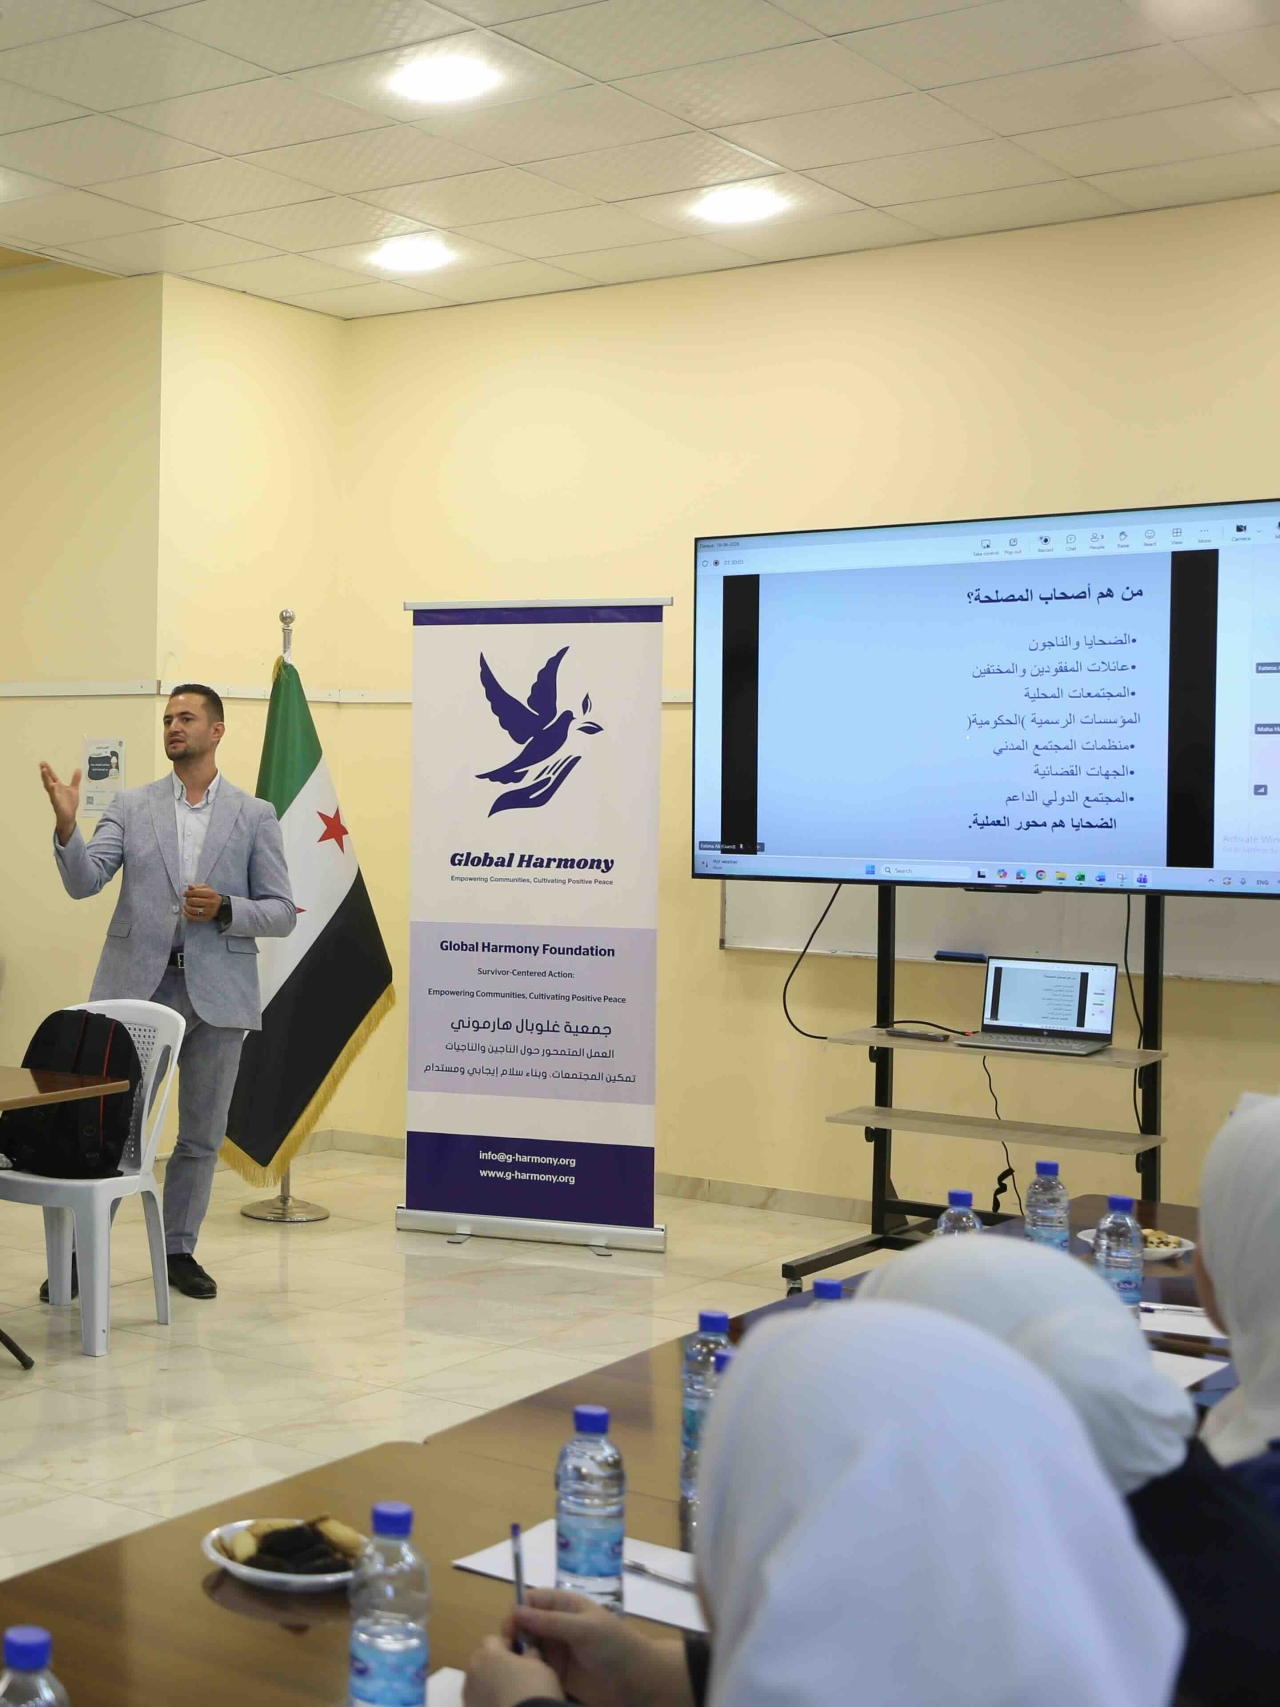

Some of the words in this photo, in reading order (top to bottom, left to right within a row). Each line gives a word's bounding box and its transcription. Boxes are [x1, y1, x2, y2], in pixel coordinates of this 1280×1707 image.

[1039, 583, 1091, 605] أصحاب
[1097, 587, 1114, 605] هم
[1121, 586, 1143, 601] من
[1024, 687, 1064, 702] المحلية
[1031, 713, 1075, 729] الرسمية
[993, 740, 1027, 756] المدني
[1032, 739, 1076, 756] المجتمع
[1005, 790, 1037, 806] الداعم
[1042, 791, 1078, 808] الدولي
[1014, 819, 1047, 830] محور
[1051, 818, 1065, 832] هم
[1071, 817, 1117, 832] الضحايا
[450, 851, 515, 868] Global
[517, 854, 614, 873] Harmony
[490, 876, 532, 884] Communities,
[533, 877, 566, 885] Cultivating
[440, 940, 479, 953] Global
[481, 941, 540, 956] Harmony
[542, 943, 615, 957] Foundation
[477, 968, 546, 978] Survivor-Centered
[548, 970, 575, 979] Action:
[428, 988, 475, 999] Empowering
[476, 989, 528, 1000] Communities,
[528, 991, 570, 1002] Cultivating
[572, 993, 602, 1003] Positive
[603, 994, 626, 1004] Peace
[450, 1017, 512, 1033] هارموني
[516, 1019, 560, 1035] غلوبال
[564, 1021, 611, 1038] جمعية
[445, 1042, 486, 1053] والناجيات
[488, 1045, 518, 1054] الناجين
[520, 1045, 539, 1056] حول
[541, 1047, 584, 1058] المتمحور
[586, 1049, 614, 1058] العمل
[423, 1063, 465, 1074] ومستدام
[467, 1066, 498, 1077] إيجابي
[500, 1067, 523, 1077] سلام
[525, 1068, 547, 1079] وبناء
[606, 1074, 636, 1083] تمكين
[479, 1150, 576, 1168] info@g-harmony.org
[479, 1168, 576, 1185] www.g-harmony.org
